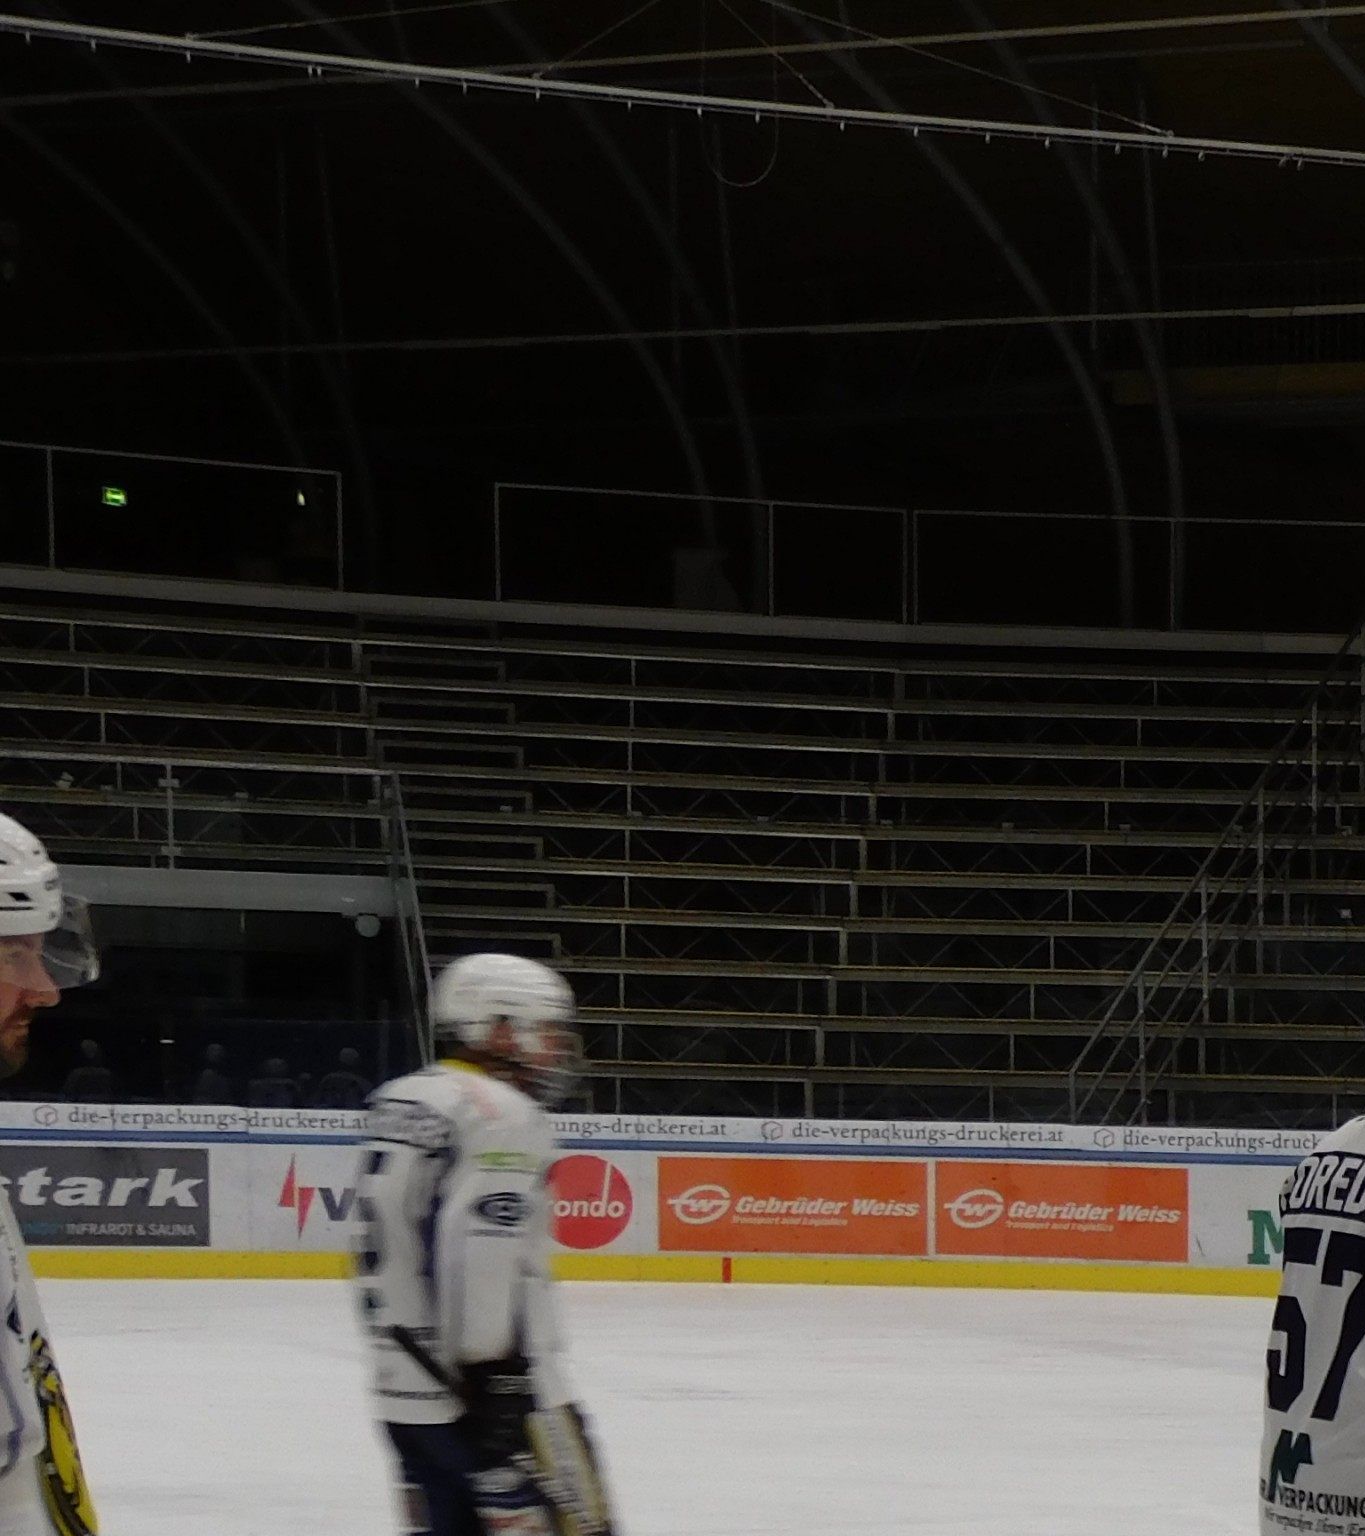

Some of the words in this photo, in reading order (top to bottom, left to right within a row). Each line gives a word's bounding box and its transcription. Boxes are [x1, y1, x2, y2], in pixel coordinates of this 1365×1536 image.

[552, 1117, 728, 1138] ungs-druckerei.at
[791, 1121, 1064, 1144] die-verpackungs-druckerei.at
[552, 1162, 625, 1219] ondo
[734, 1195, 849, 1217] Gebrüder
[850, 1197, 920, 1218] Weiss
[1007, 1199, 1115, 1222] Gebrüder
[1116, 1203, 1182, 1224] Weiss
[147, 1223, 197, 1237] SAUNA
